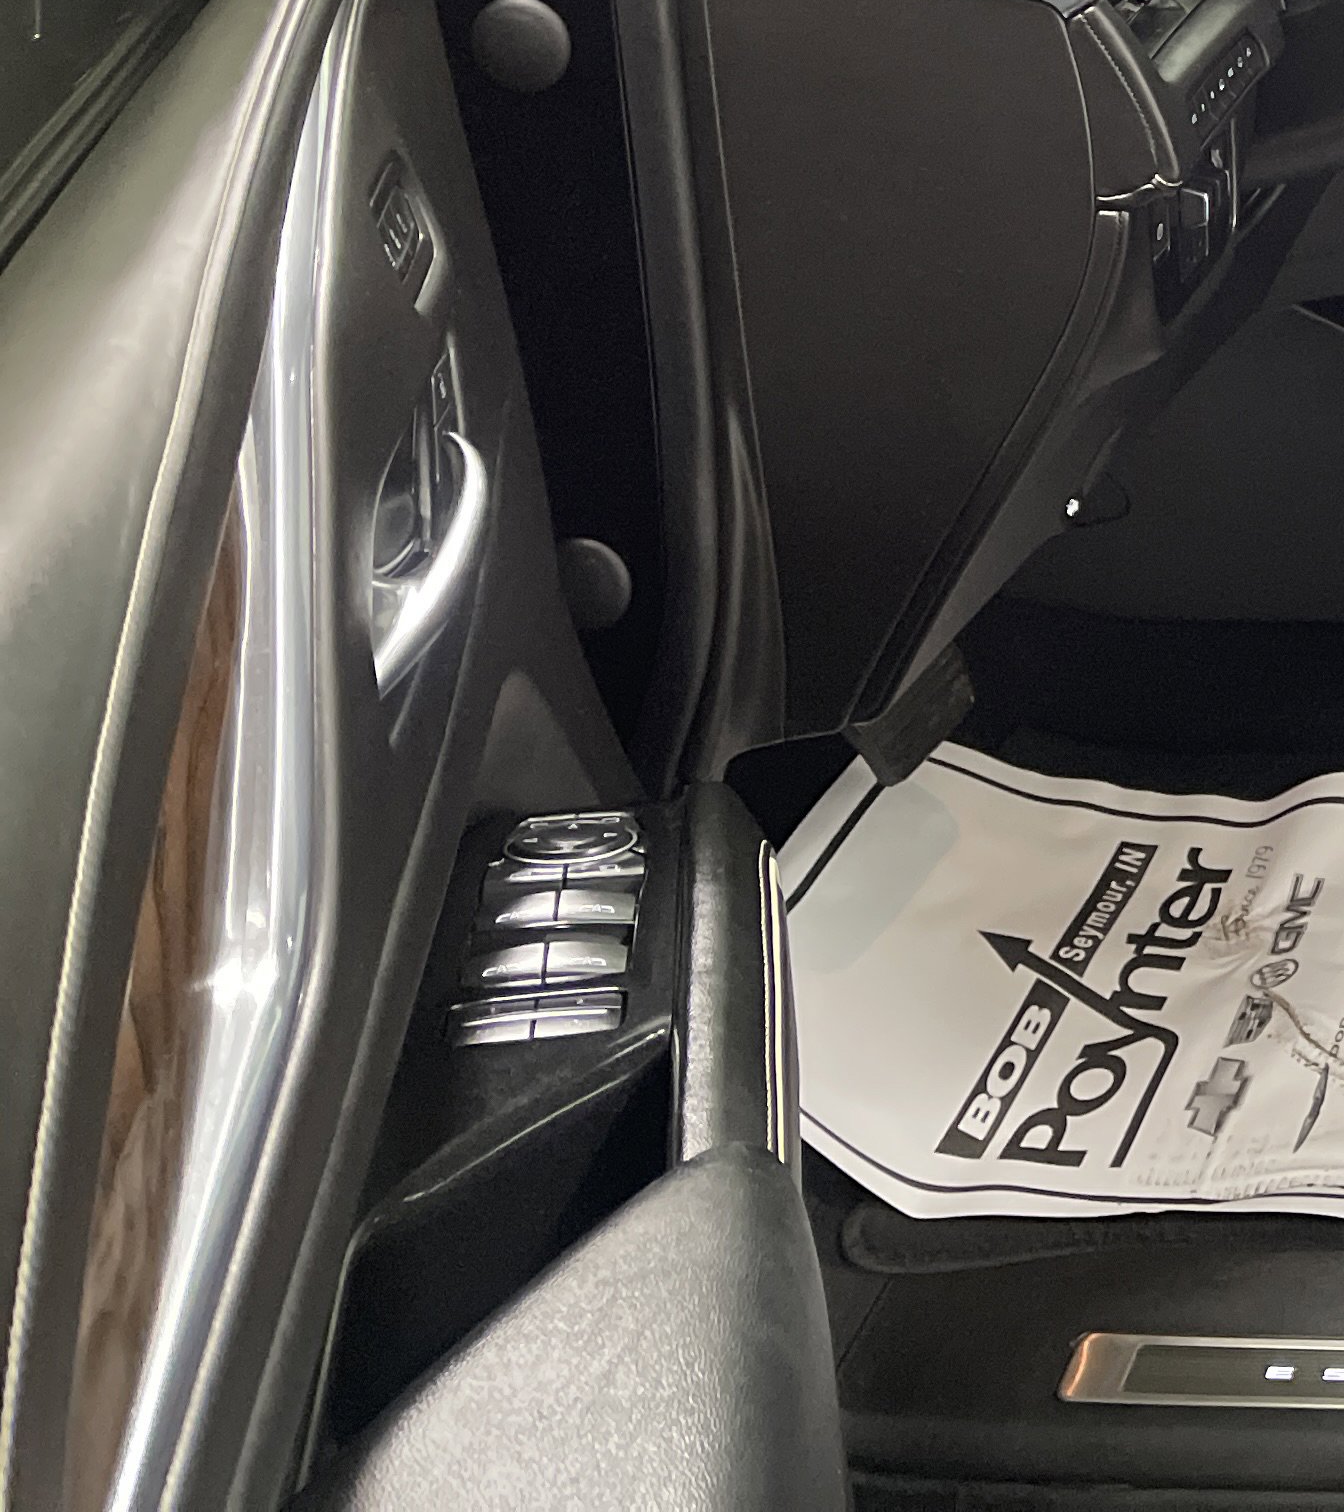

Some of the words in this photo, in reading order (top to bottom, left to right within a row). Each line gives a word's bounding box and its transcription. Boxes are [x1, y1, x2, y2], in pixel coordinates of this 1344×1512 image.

[1058, 878, 1136, 963] Seymour,
[1114, 847, 1147, 874] IN
[1245, 845, 1274, 880] 1979
[1267, 872, 1325, 955] GMC
[996, 846, 1234, 1169] Poynter
[957, 1004, 1052, 1141] BOB
